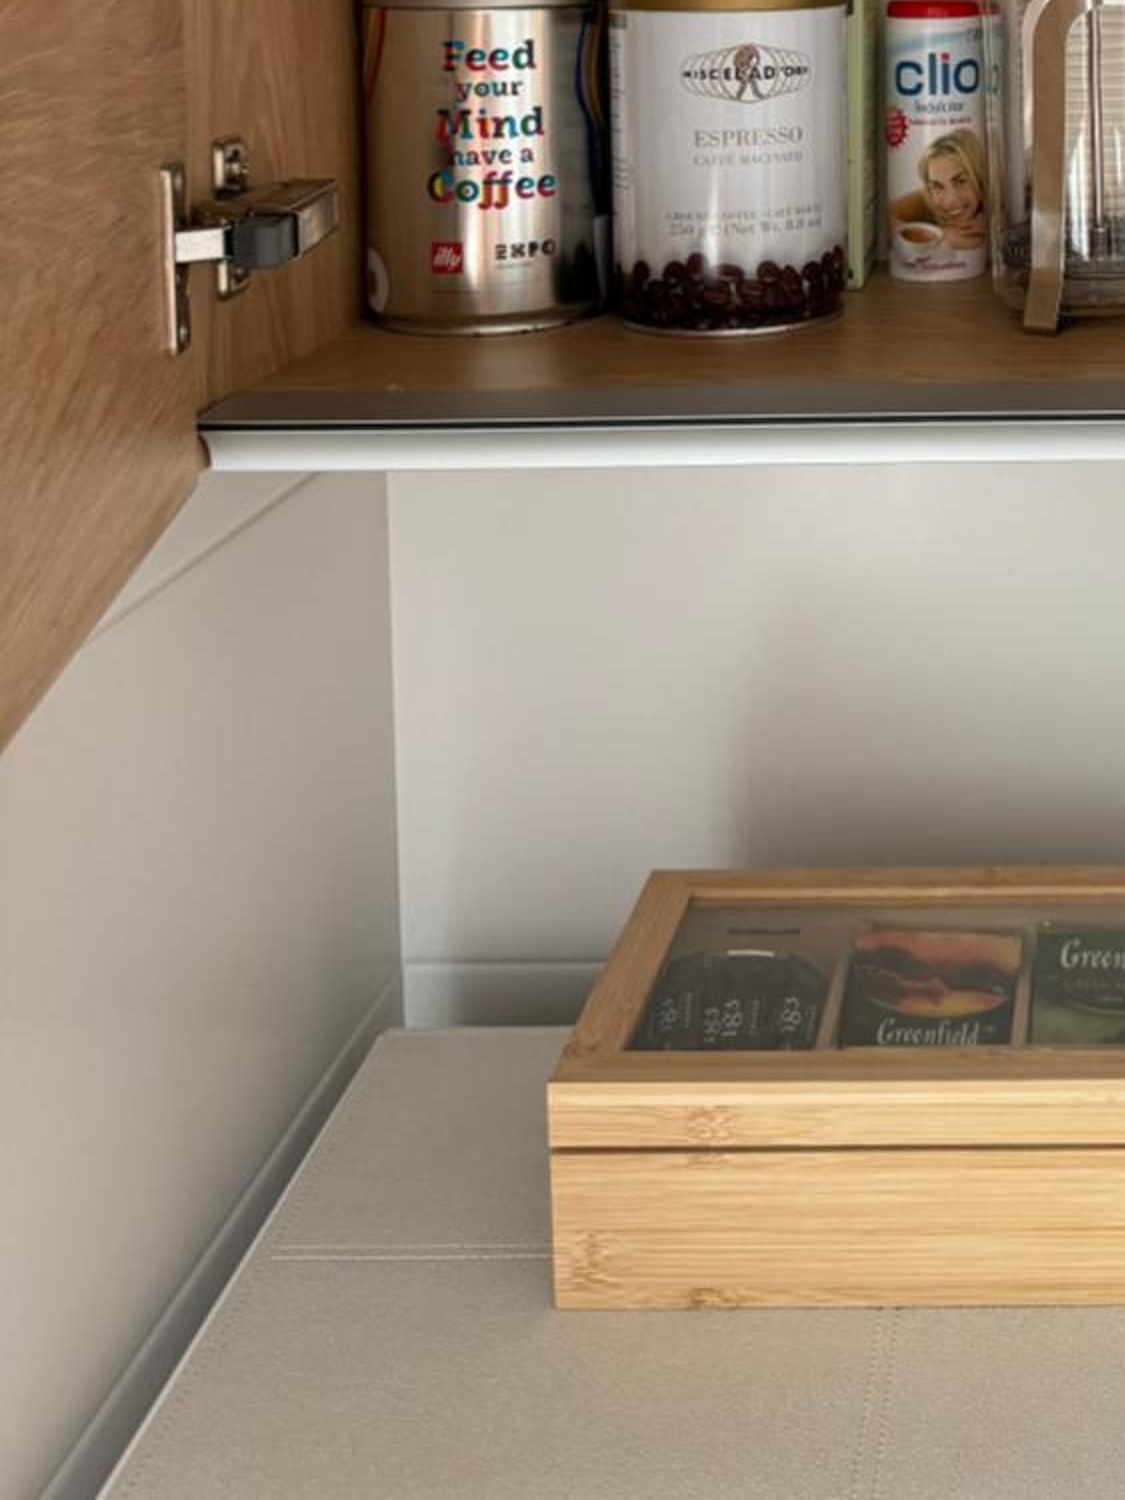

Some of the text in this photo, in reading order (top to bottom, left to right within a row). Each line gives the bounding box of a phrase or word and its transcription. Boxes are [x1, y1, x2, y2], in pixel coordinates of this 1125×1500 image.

[443, 38, 537, 71] Feed
[895, 52, 979, 96] clio
[455, 81, 523, 102] your
[436, 106, 545, 140] Mind
[693, 127, 803, 148] ESPRESSO
[448, 143, 534, 166] have a
[427, 168, 557, 210] Coffee
[433, 245, 463, 271] illy
[495, 240, 557, 260] EXPO
[877, 1017, 980, 1045] Greenfield
